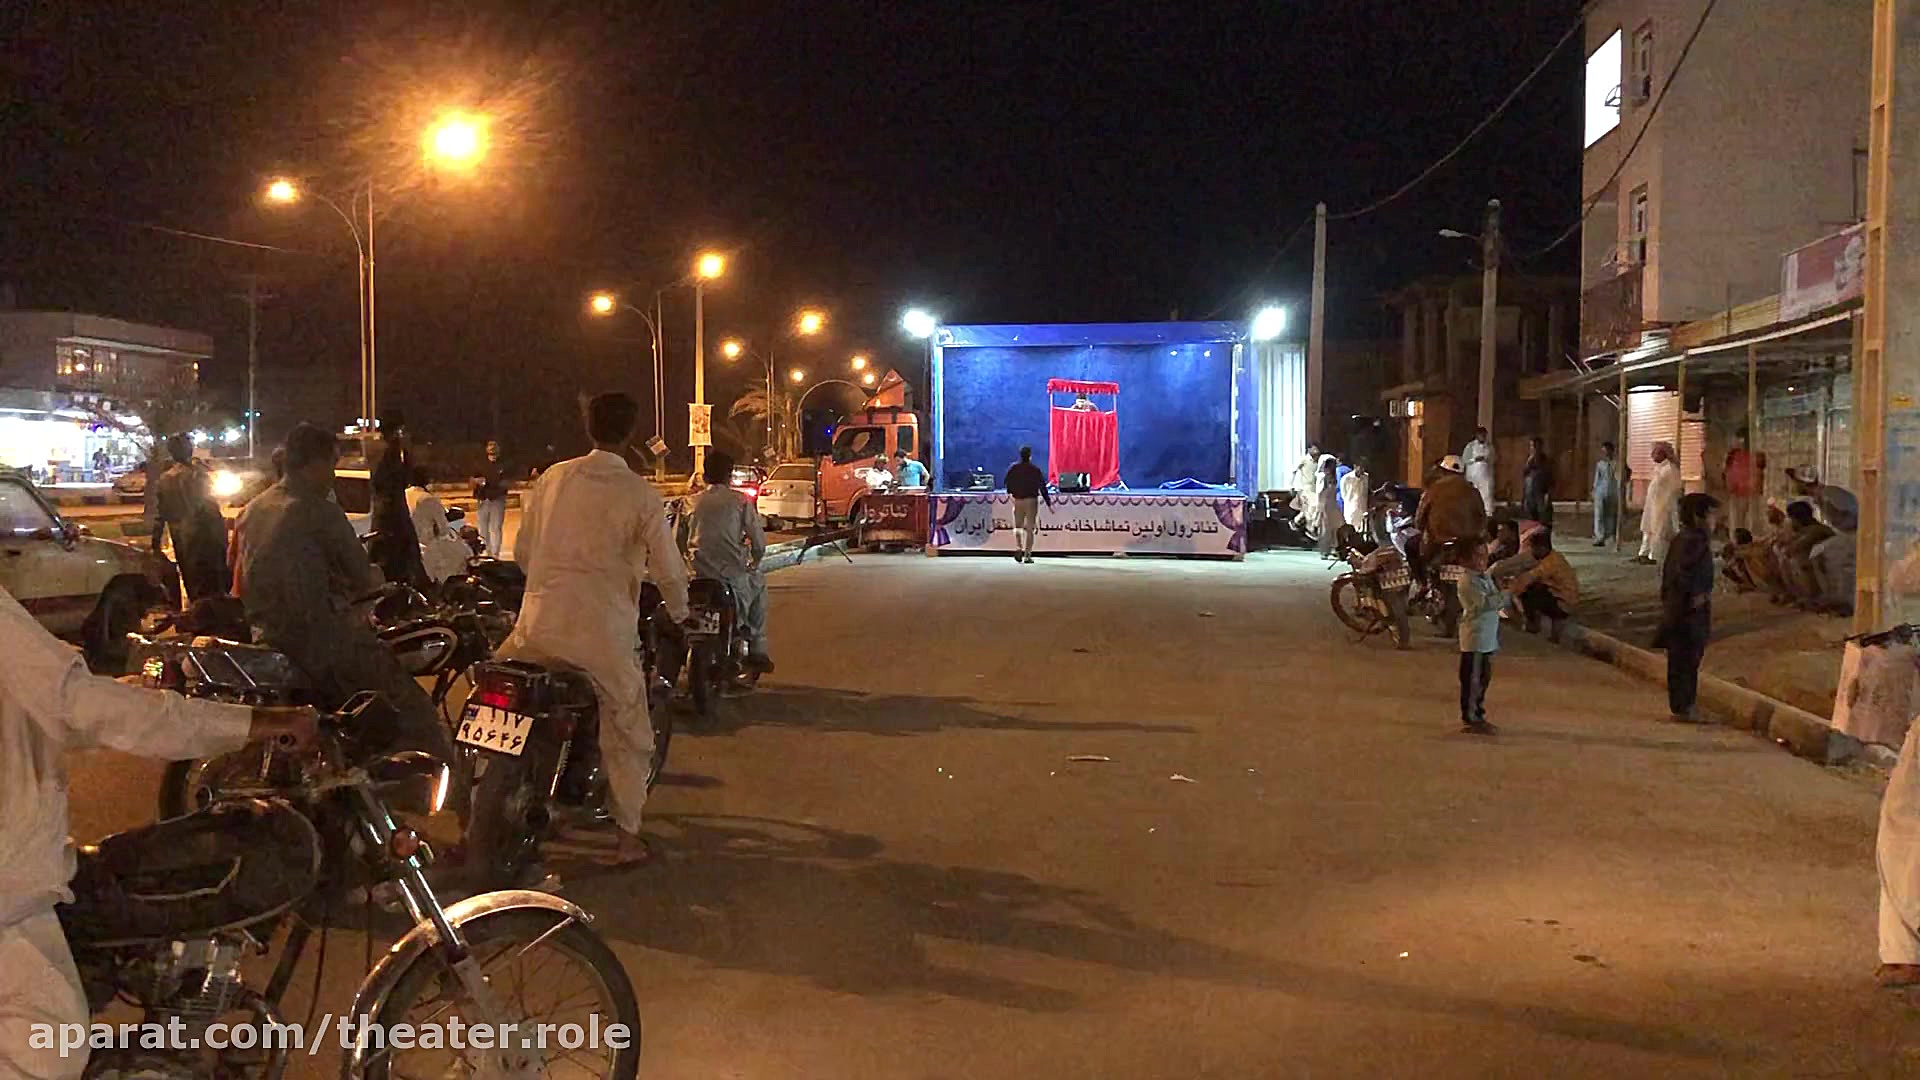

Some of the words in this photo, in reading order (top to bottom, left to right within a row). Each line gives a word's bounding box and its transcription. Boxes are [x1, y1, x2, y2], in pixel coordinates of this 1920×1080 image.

[955, 518, 985, 536] ایران
[1065, 519, 1130, 532] تماشاخانه
[1132, 520, 1166, 538] اولین
